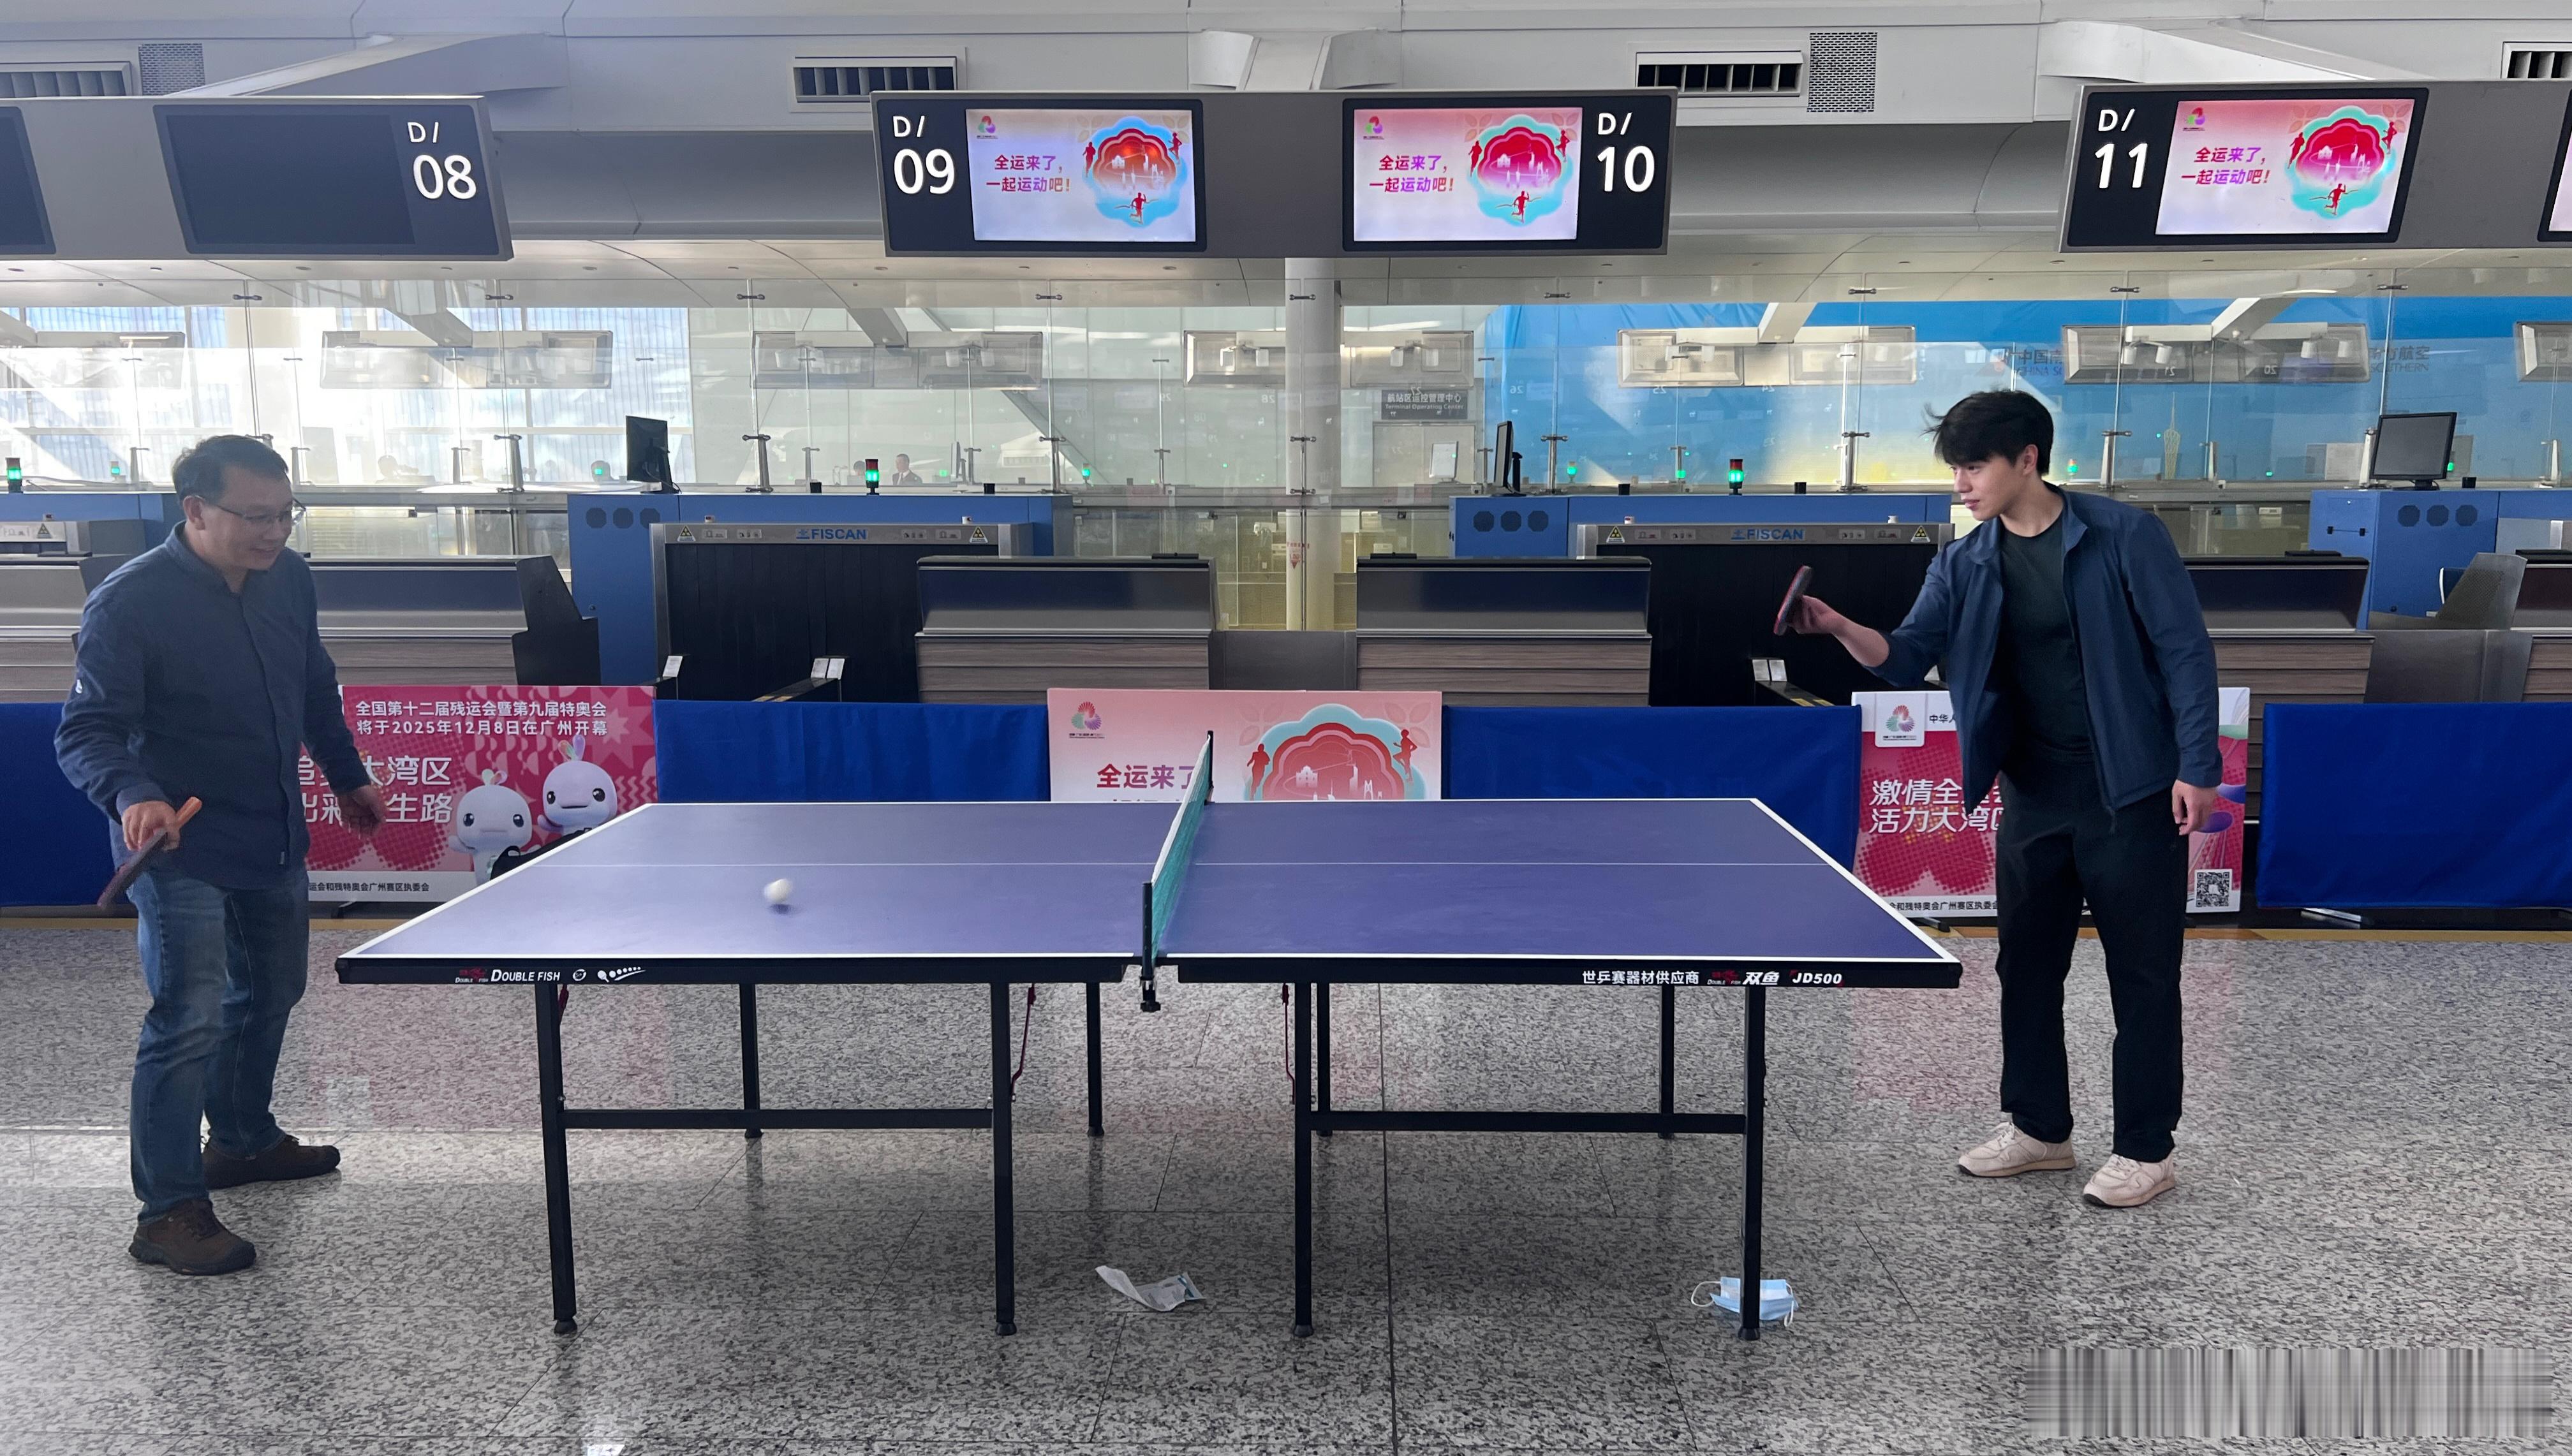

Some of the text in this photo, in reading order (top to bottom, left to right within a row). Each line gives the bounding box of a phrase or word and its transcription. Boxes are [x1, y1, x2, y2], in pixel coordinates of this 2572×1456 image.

[892, 115, 925, 138] D/
[1597, 112, 1632, 135] D/
[2098, 108, 2135, 131] D/
[894, 149, 955, 195] 09
[1597, 145, 1655, 192] 10
[2095, 143, 2148, 189] 11
[413, 154, 477, 200] 08
[812, 529, 866, 540] FISCAN
[1747, 528, 1803, 540] FISCAN
[355, 701, 607, 717] 全国第十二届残运会暨第九届特奥会
[357, 720, 608, 736] 将于2025年12月8日在广州开幕
[491, 968, 535, 982] DOUBLE
[537, 971, 560, 982] FISH
[1582, 970, 1699, 984] 世乒赛器材供应商
[1742, 971, 1780, 985] 双鱼
[1792, 973, 1842, 984] JD500
